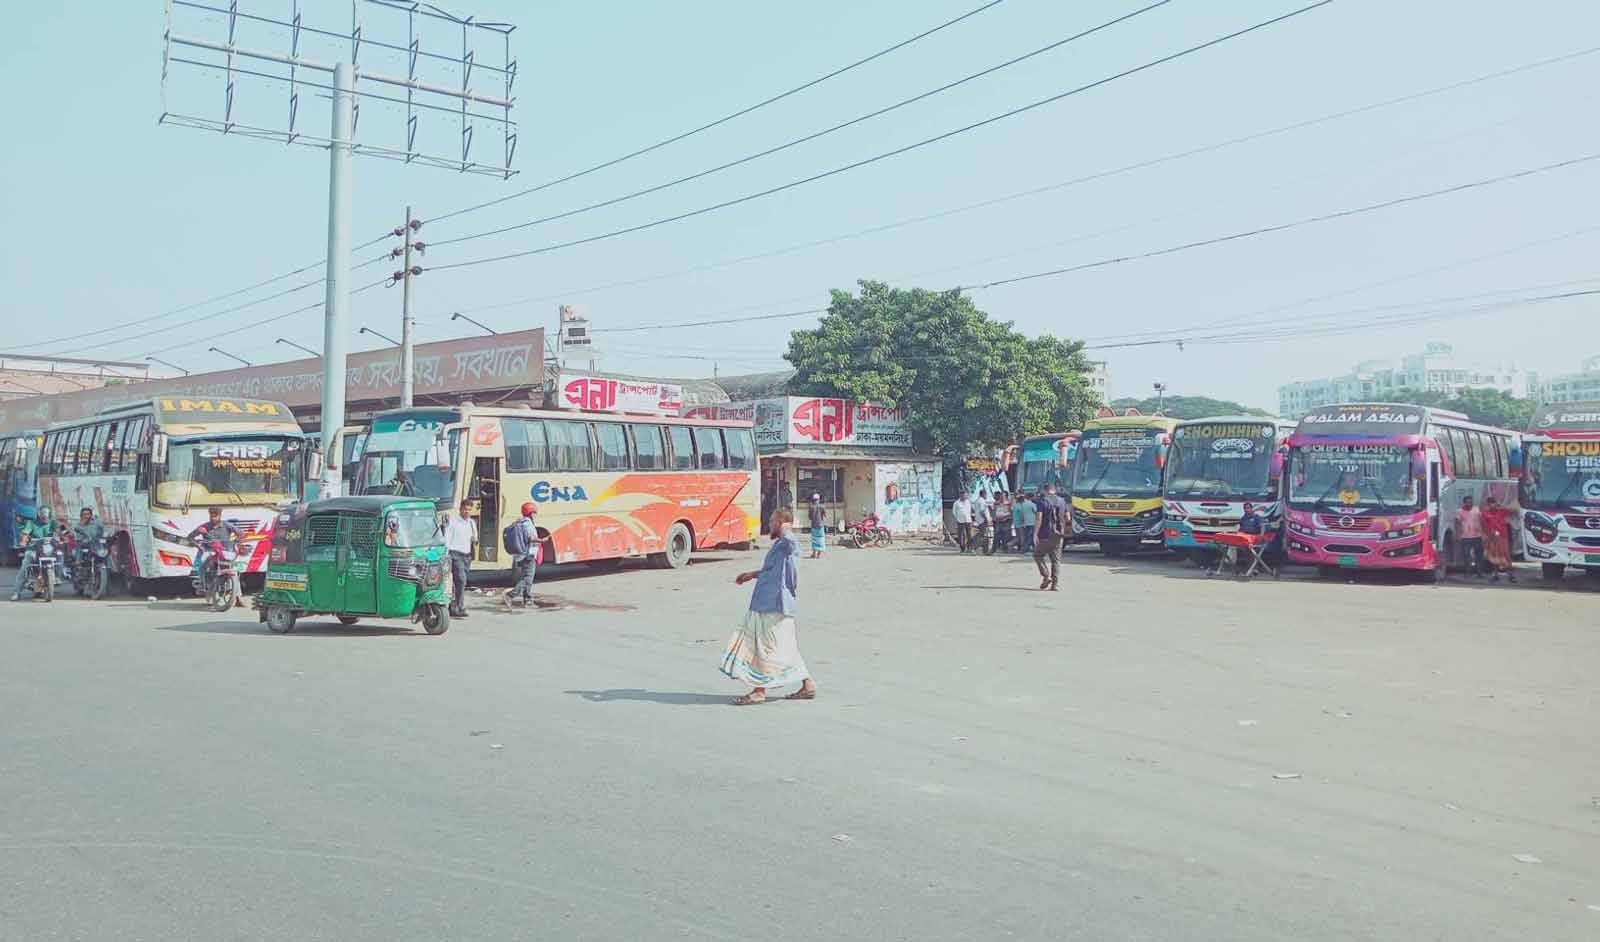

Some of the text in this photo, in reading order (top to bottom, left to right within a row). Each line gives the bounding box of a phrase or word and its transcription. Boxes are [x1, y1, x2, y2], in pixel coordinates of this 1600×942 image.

[453, 344, 532, 381] সবখানে
[162, 399, 279, 416] IMAM
[564, 377, 618, 410] এনা
[793, 399, 854, 442] এনা
[1315, 413, 1405, 423] ALAM ASIA
